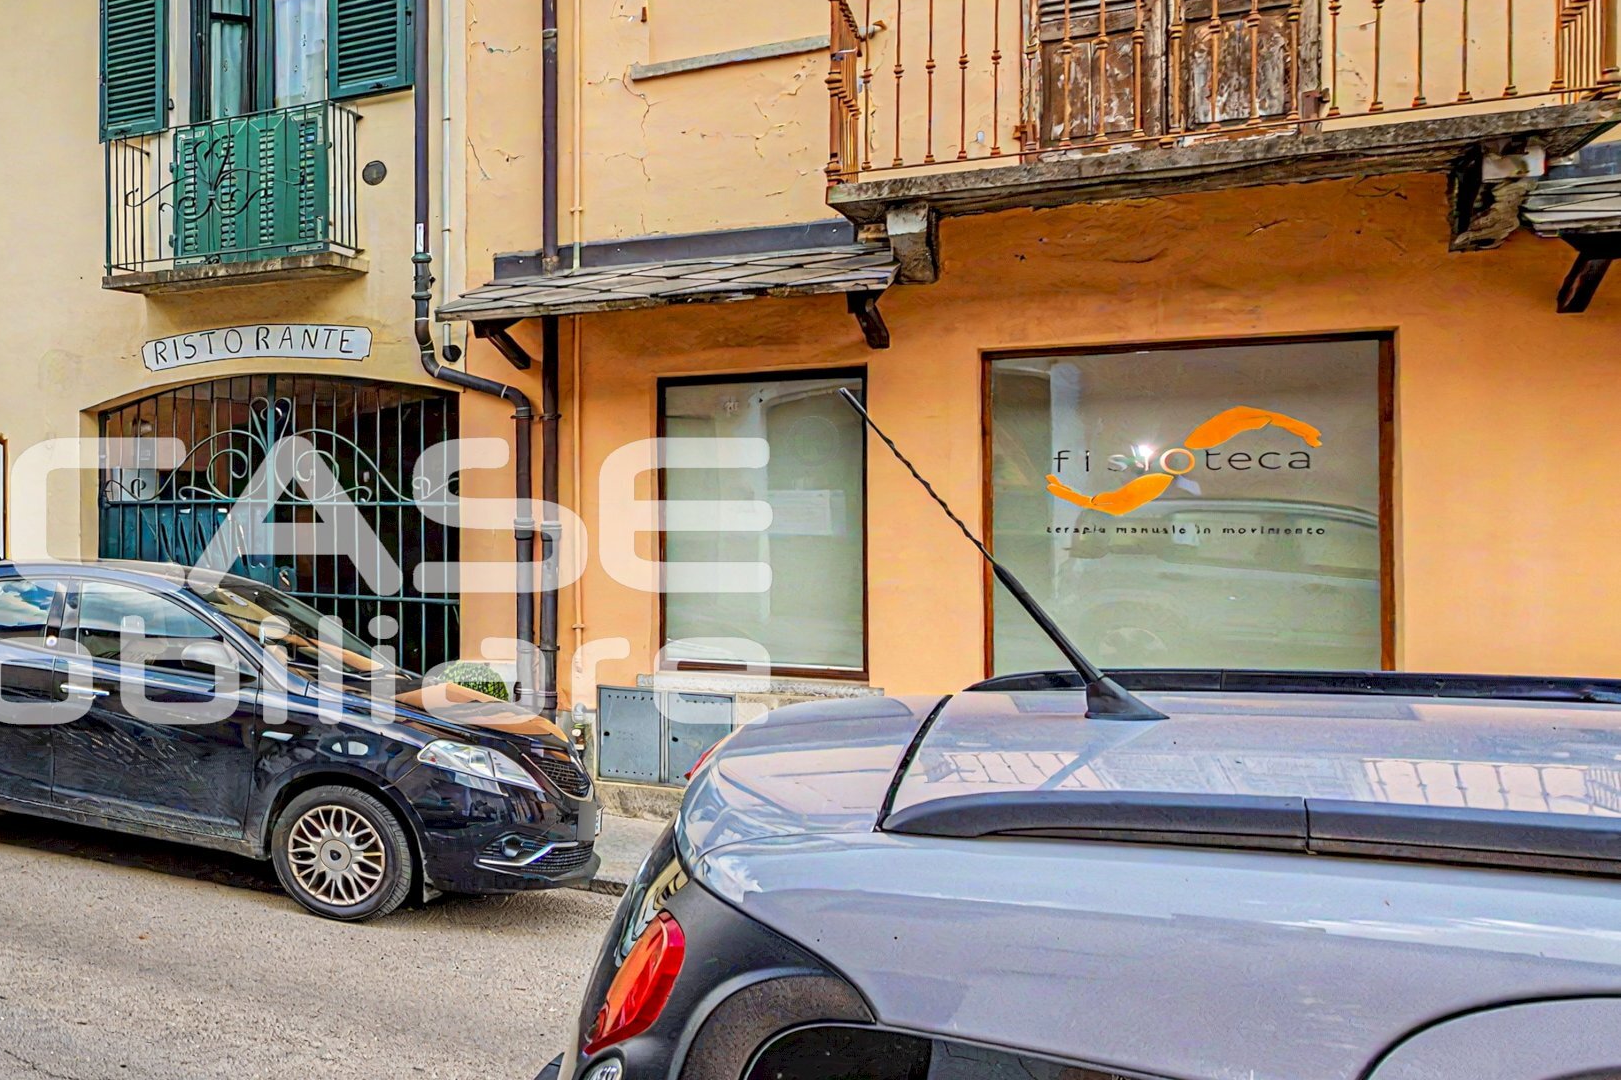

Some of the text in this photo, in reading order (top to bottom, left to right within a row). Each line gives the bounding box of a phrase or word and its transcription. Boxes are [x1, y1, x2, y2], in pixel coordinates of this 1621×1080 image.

[153, 326, 356, 366] RISTORANTE
[1046, 524, 1326, 536] terapia manuale in movimento
